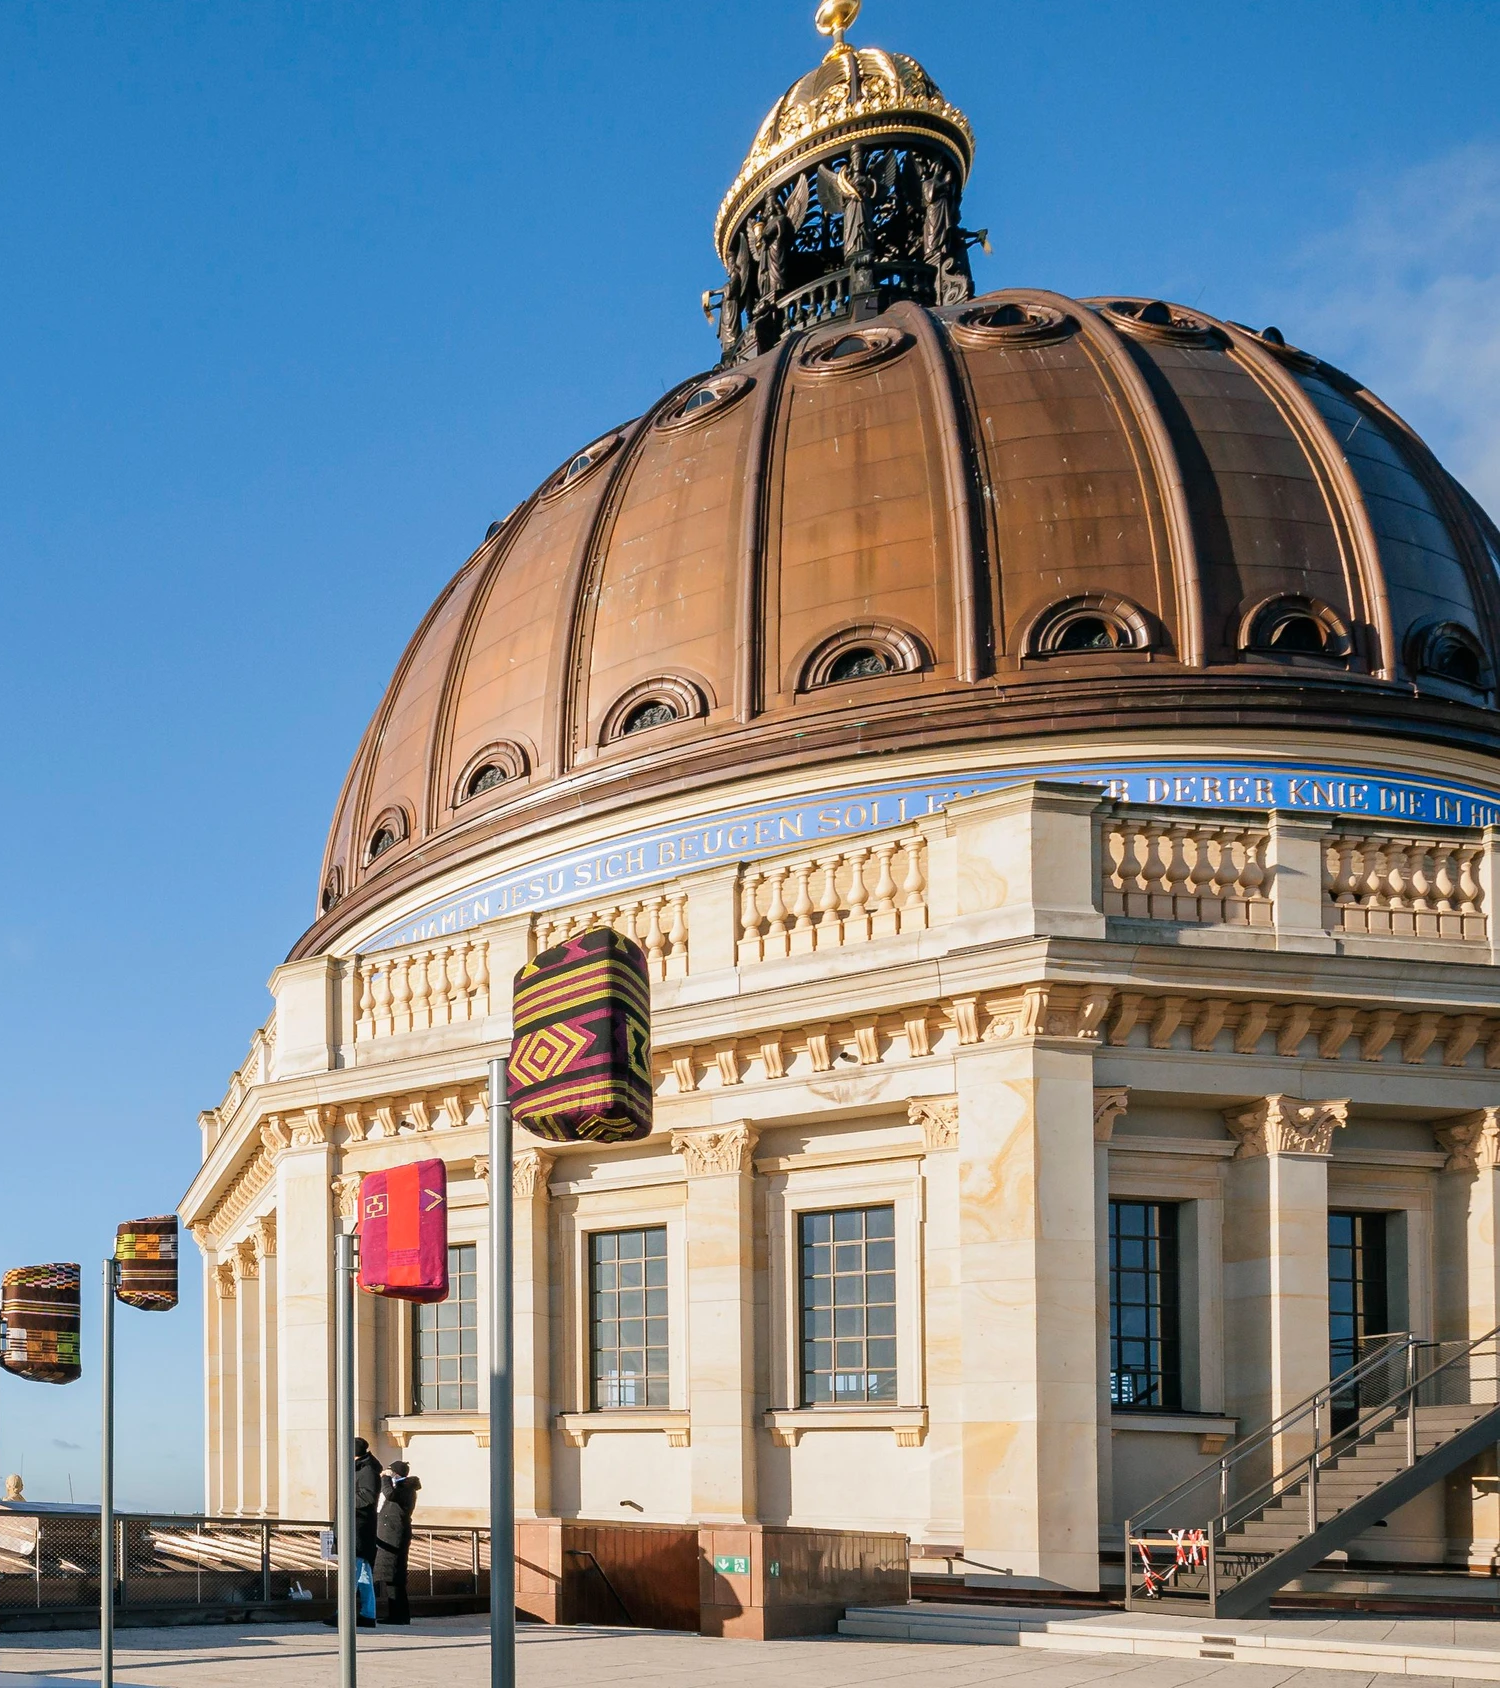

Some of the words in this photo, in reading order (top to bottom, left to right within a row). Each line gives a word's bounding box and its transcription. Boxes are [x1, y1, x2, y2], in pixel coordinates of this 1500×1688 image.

[412, 897, 490, 942] NAMEN
[498, 871, 565, 911] JESU
[574, 847, 644, 887] SICH
[657, 813, 803, 866] BEUGEN
[818, 789, 979, 832] SOLLE
[1146, 776, 1277, 804] DERER
[1288, 779, 1369, 810] KNIE
[1379, 786, 1427, 817] DIE
[1435, 795, 1463, 824] IM
